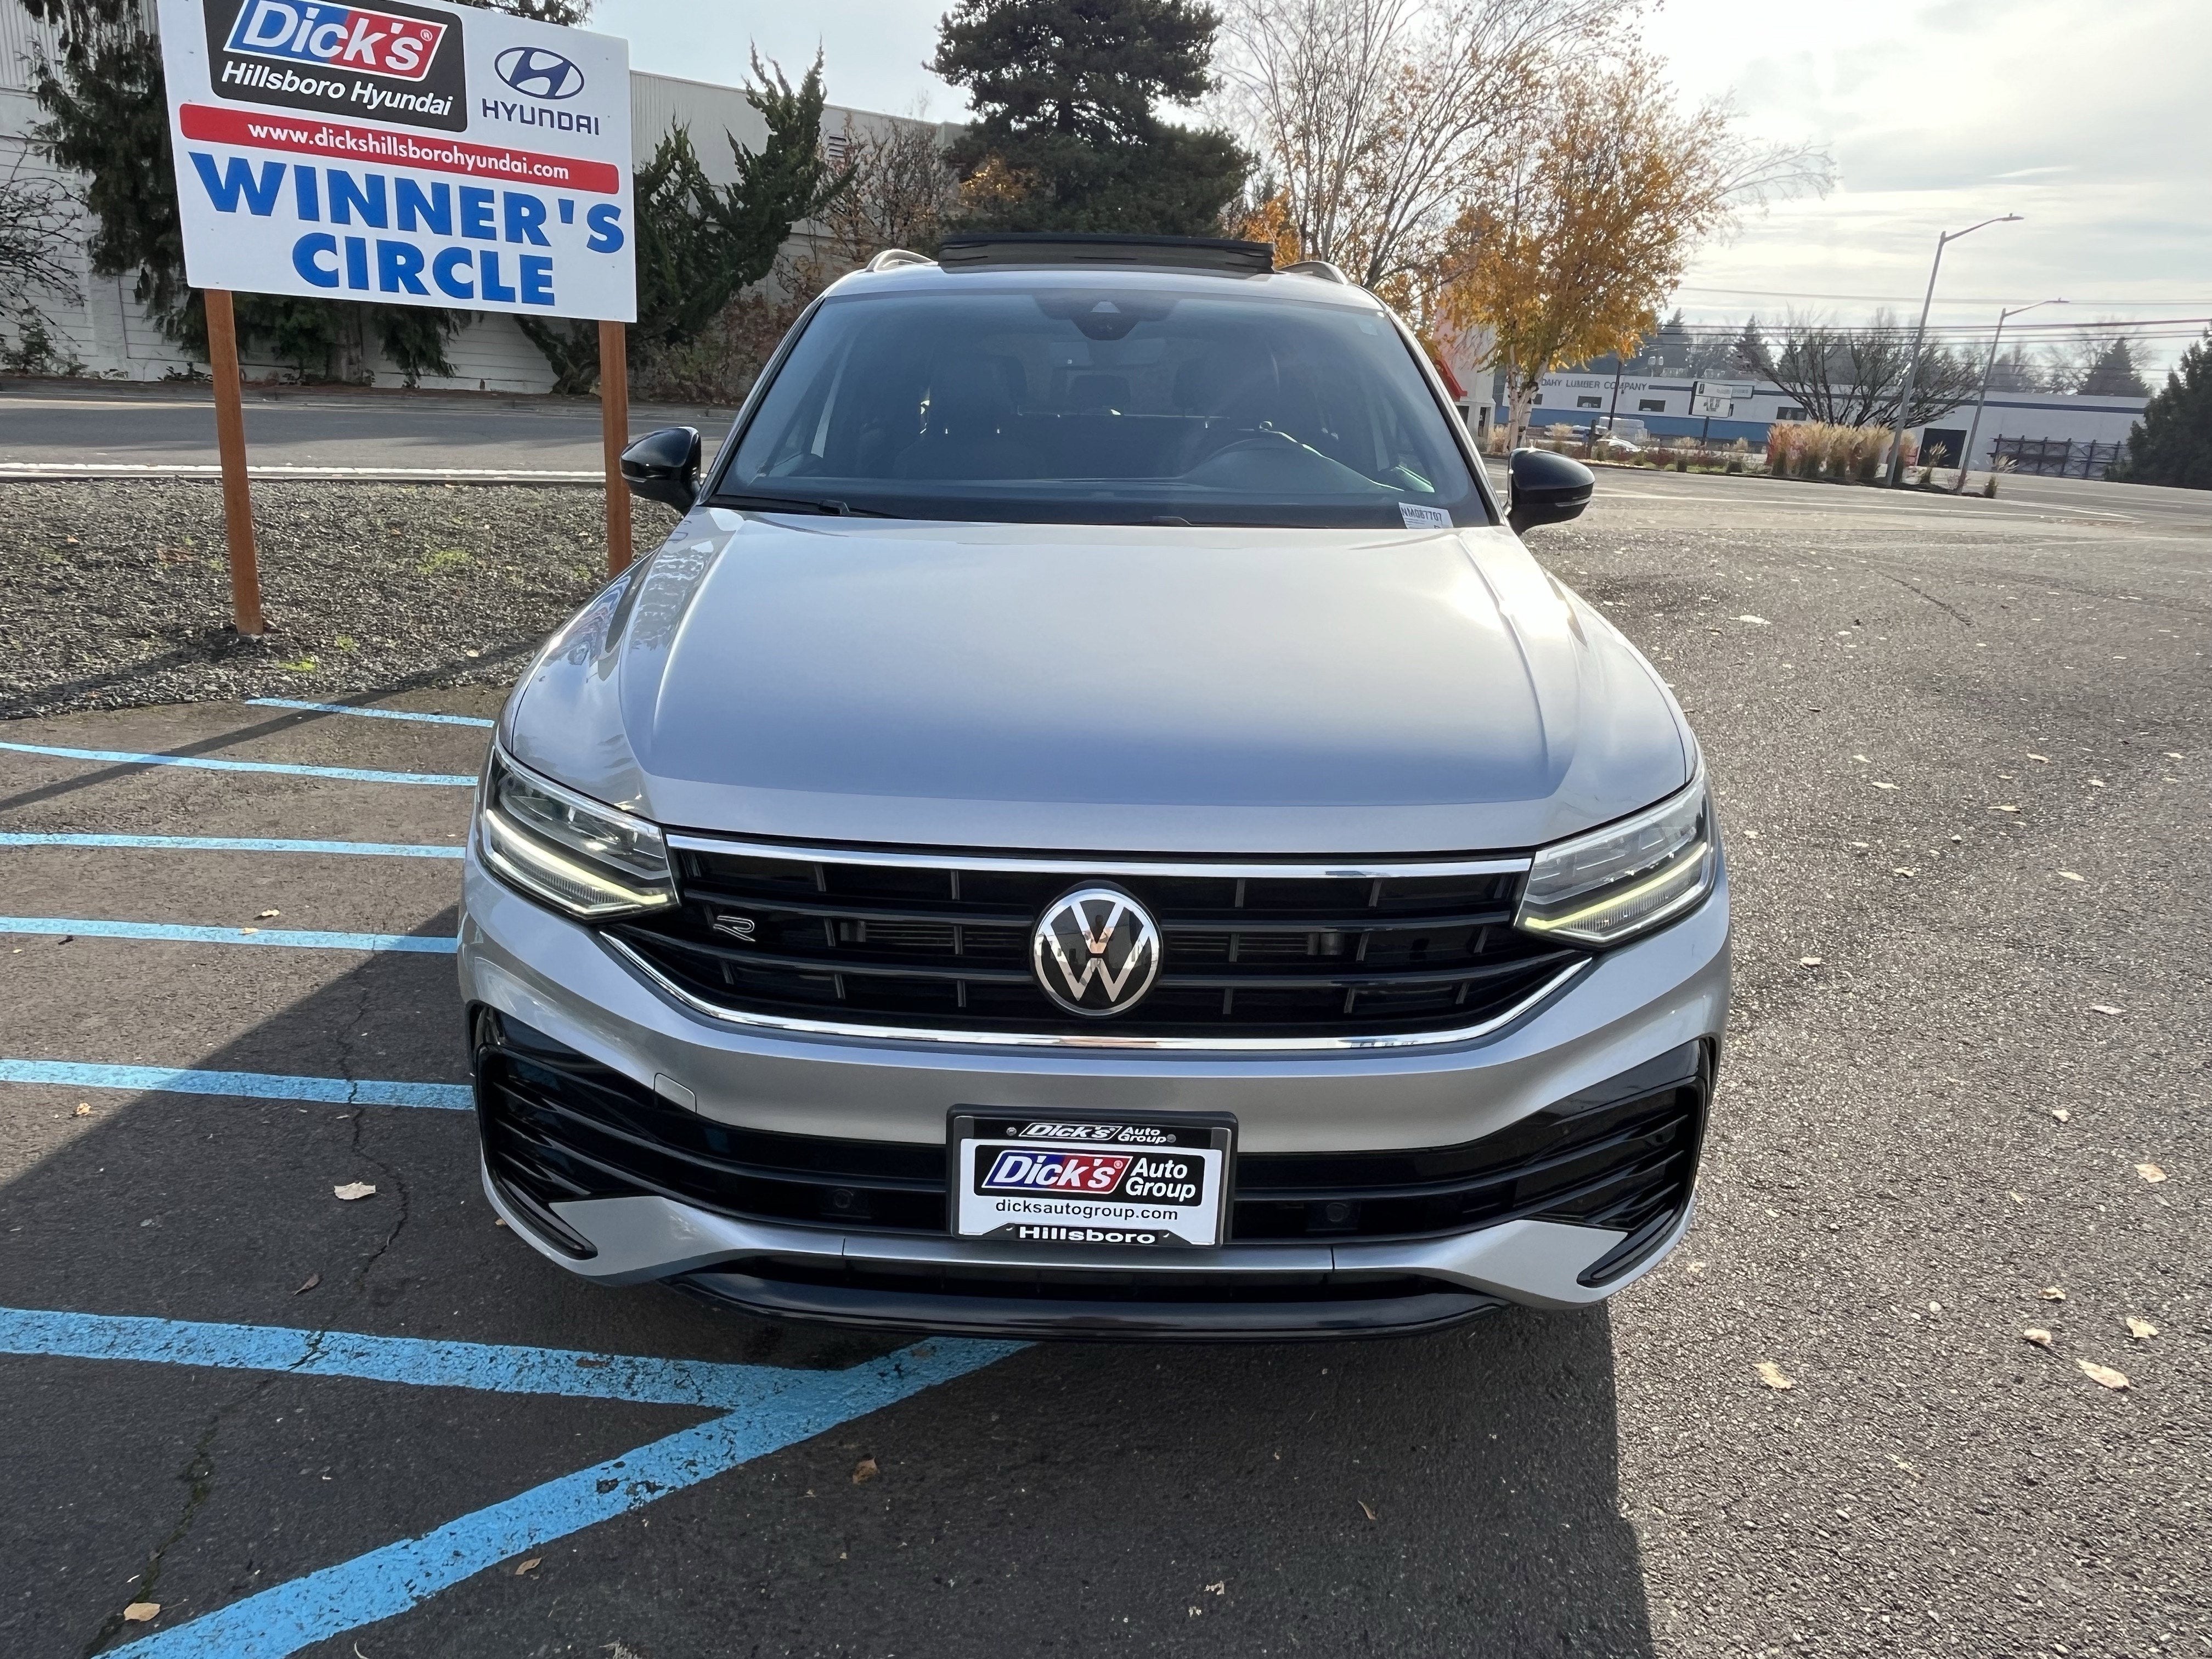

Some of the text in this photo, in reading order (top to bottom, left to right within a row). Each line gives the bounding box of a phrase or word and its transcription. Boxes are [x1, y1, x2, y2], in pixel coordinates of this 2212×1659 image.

[221, 60, 454, 116] Hillsboro Hyundai
[482, 98, 600, 136] HYUNDAI
[247, 121, 569, 180] www.dickshillsborohyundai.com
[188, 151, 625, 254] WINNER'S
[292, 232, 556, 306] CIRCLE
[1566, 379, 1600, 388] LUMBER
[1118, 1133, 1167, 1144] Group
[1121, 1126, 1161, 1136] Auto
[1130, 1157, 1188, 1180] Auto
[1126, 1178, 1196, 1201] Group
[995, 1199, 1178, 1221] dicksautogroup.com
[1019, 1226, 1156, 1244] Hillsboro
